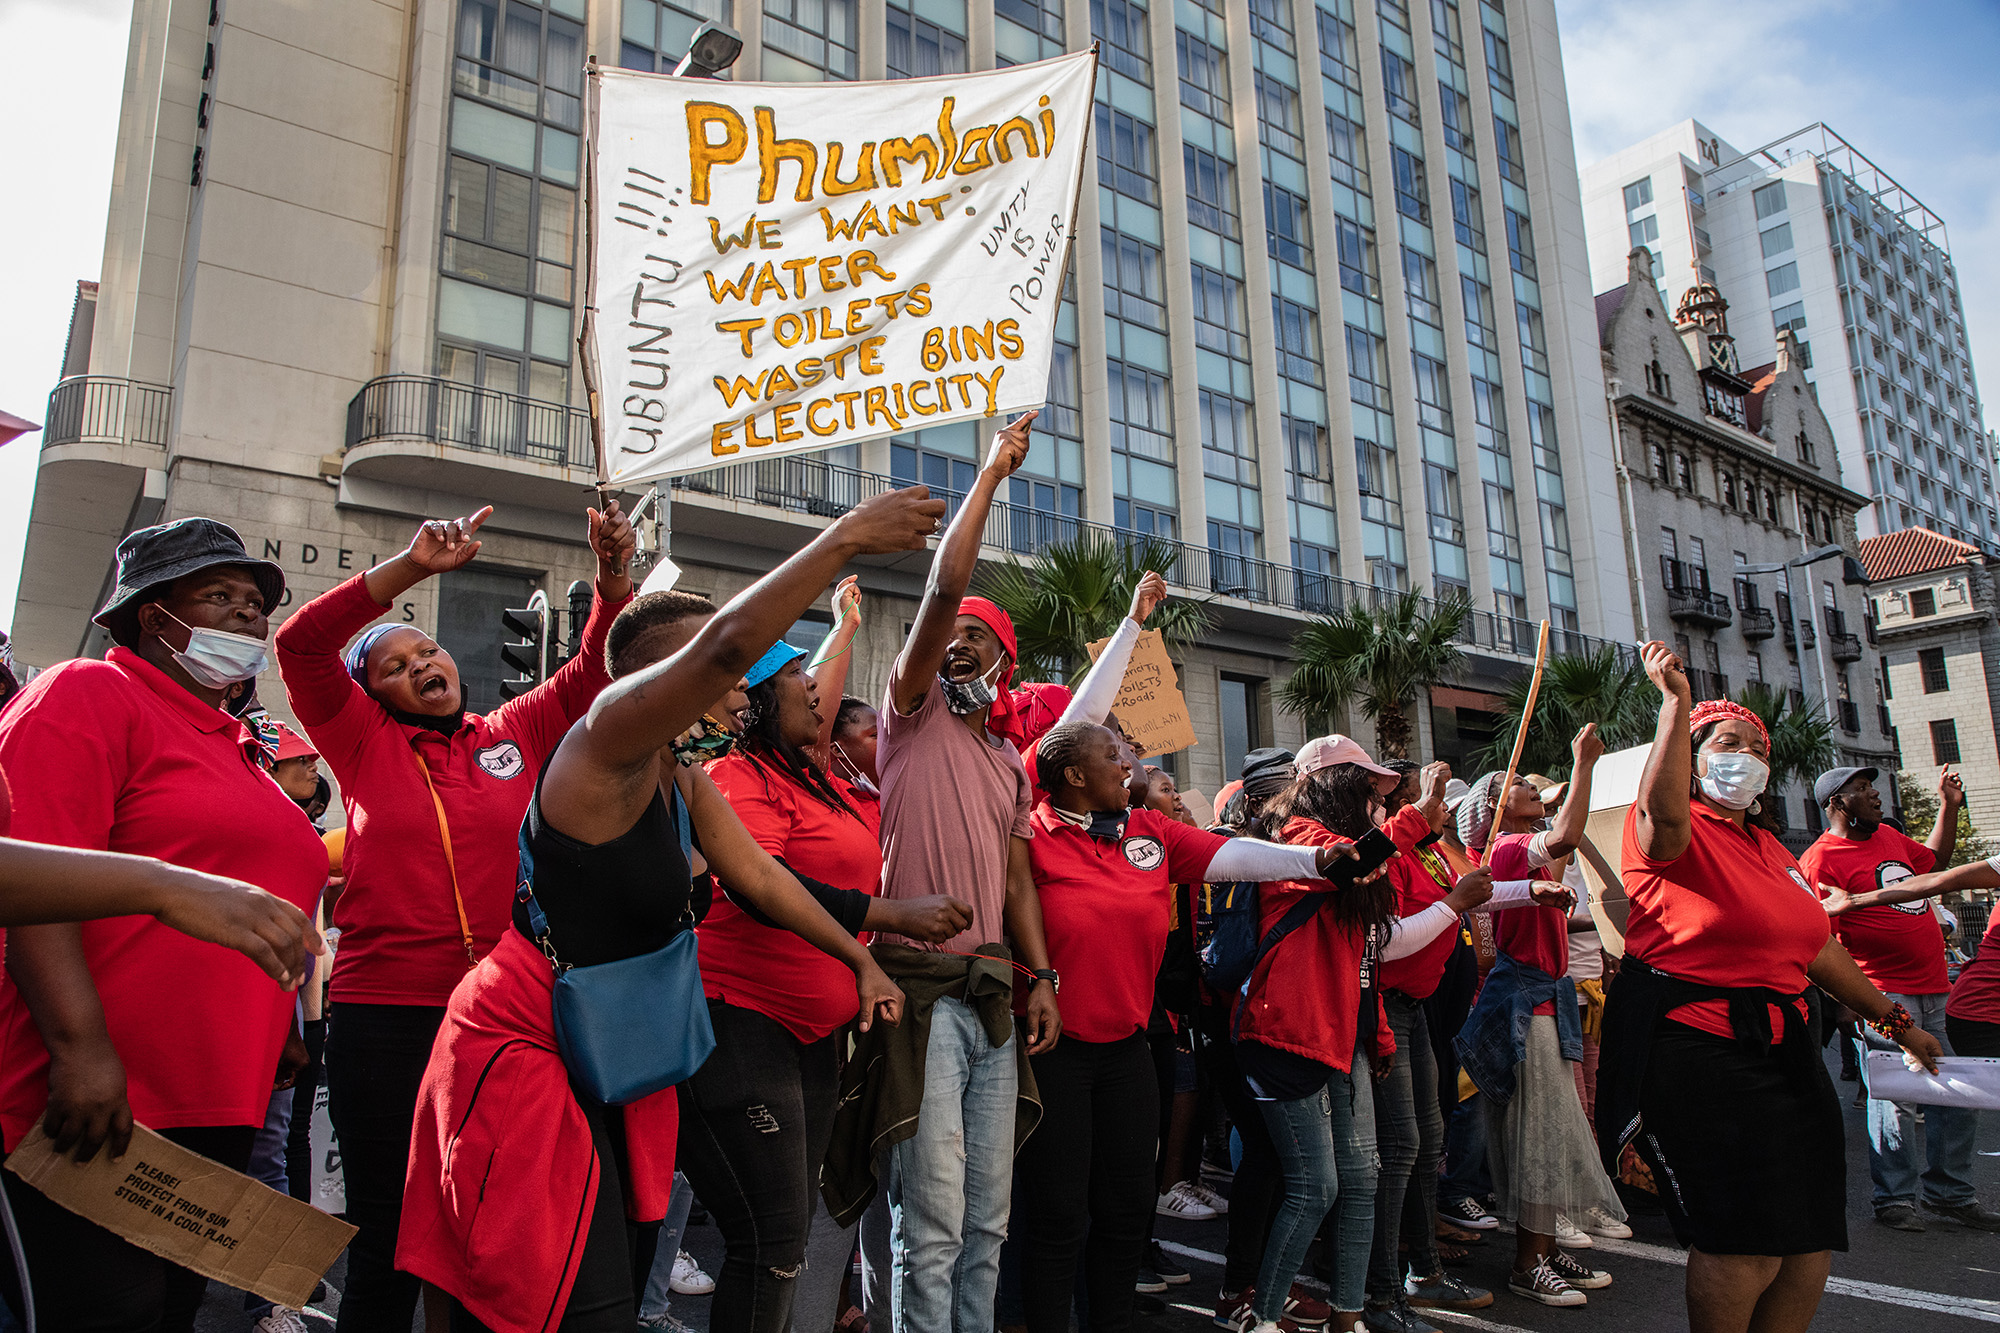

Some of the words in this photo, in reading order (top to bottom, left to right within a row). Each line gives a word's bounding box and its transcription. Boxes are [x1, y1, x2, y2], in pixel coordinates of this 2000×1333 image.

[684, 95, 1056, 206] Phumlani
[706, 212, 783, 254] WE
[819, 186, 976, 241] WANT:
[980, 178, 1030, 257] UNITY
[1011, 228, 1035, 258] IS
[703, 249, 897, 306] WATER
[1009, 213, 1064, 314] POWER
[715, 283, 933, 358] TOILETS
[713, 336, 887, 409] WASTE
[921, 318, 1025, 372] BINS
[711, 366, 1005, 457] ELECTRICITY
[124, 1173, 176, 1203] PROTECT
[173, 1197, 208, 1219] FROM
[206, 1212, 231, 1229] SUN
[134, 1161, 182, 1190] PLEASE!
[115, 1186, 153, 1210] STORE
[150, 1203, 166, 1217] IN
[163, 1211, 175, 1222] A
[174, 1215, 204, 1236] COOL
[203, 1228, 239, 1250] PLACE
